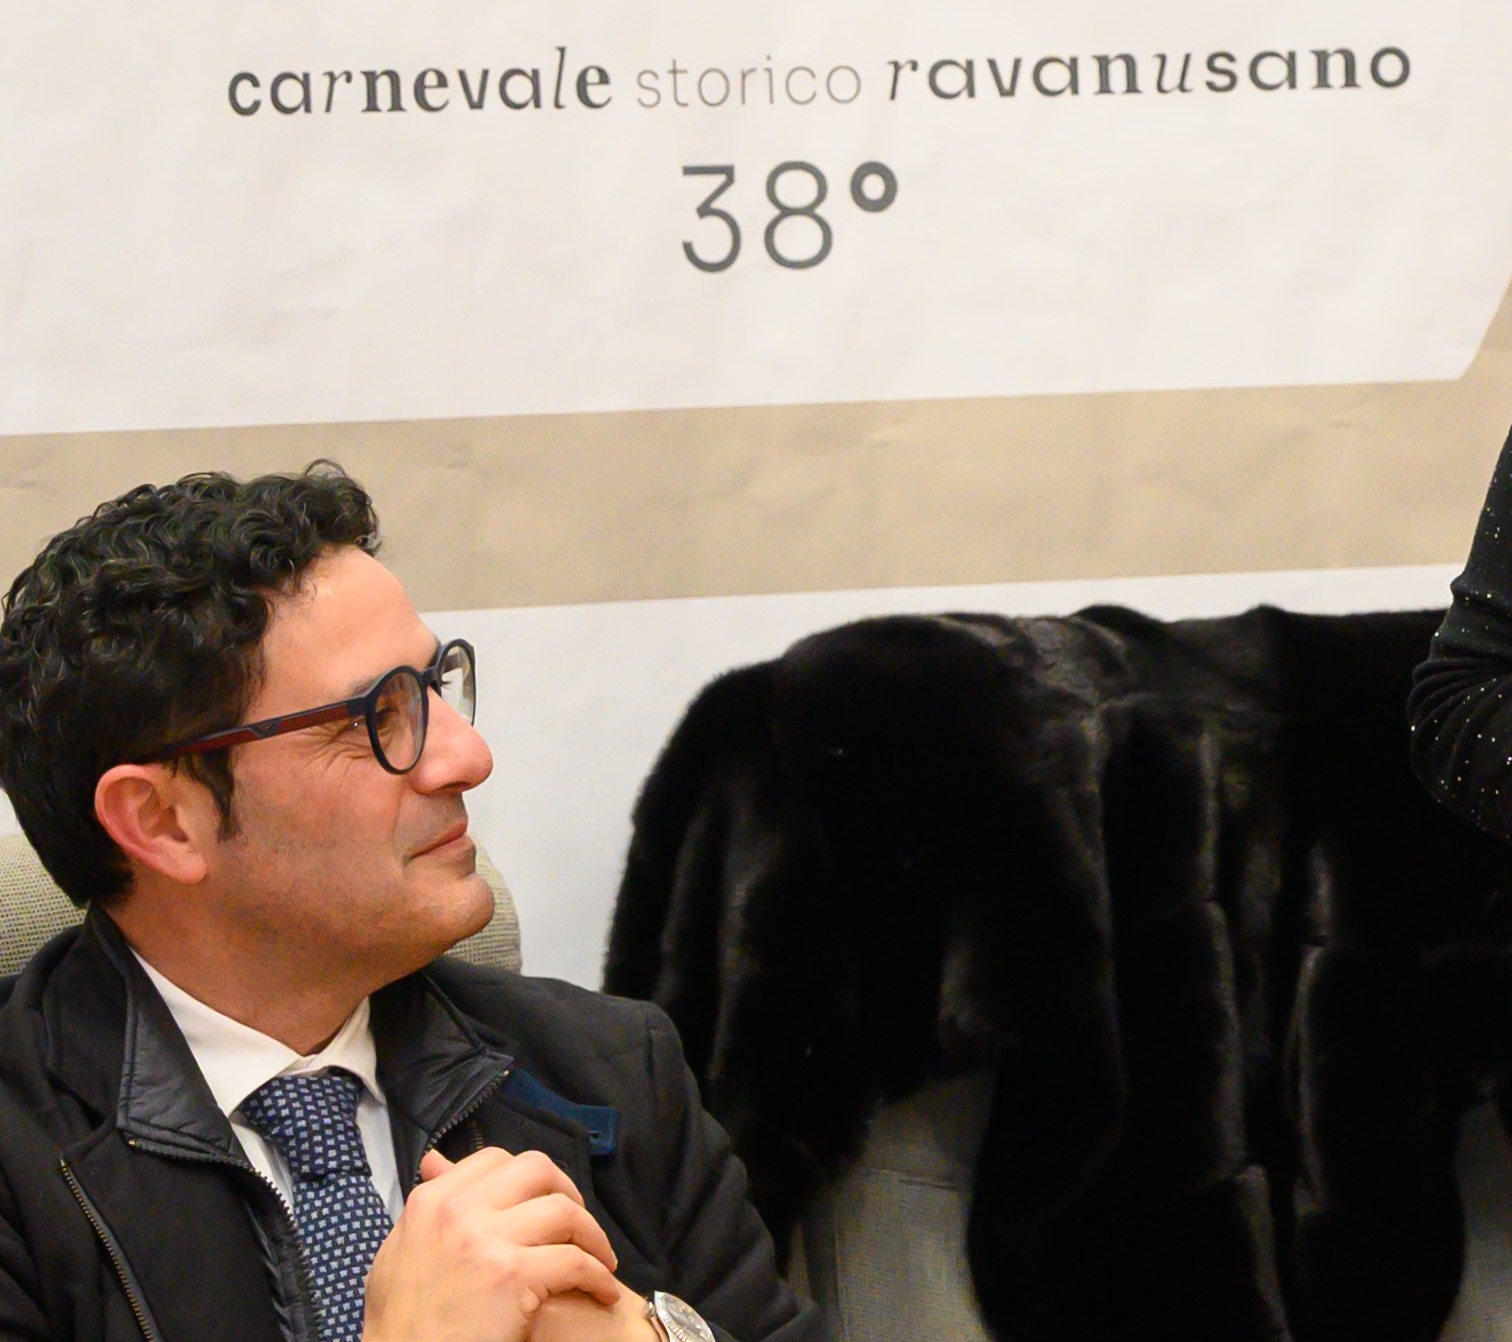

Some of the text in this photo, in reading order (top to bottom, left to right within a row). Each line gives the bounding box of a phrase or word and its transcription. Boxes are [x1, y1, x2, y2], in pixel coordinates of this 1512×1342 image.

[226, 42, 1413, 119] carnevale storico ravanusano
